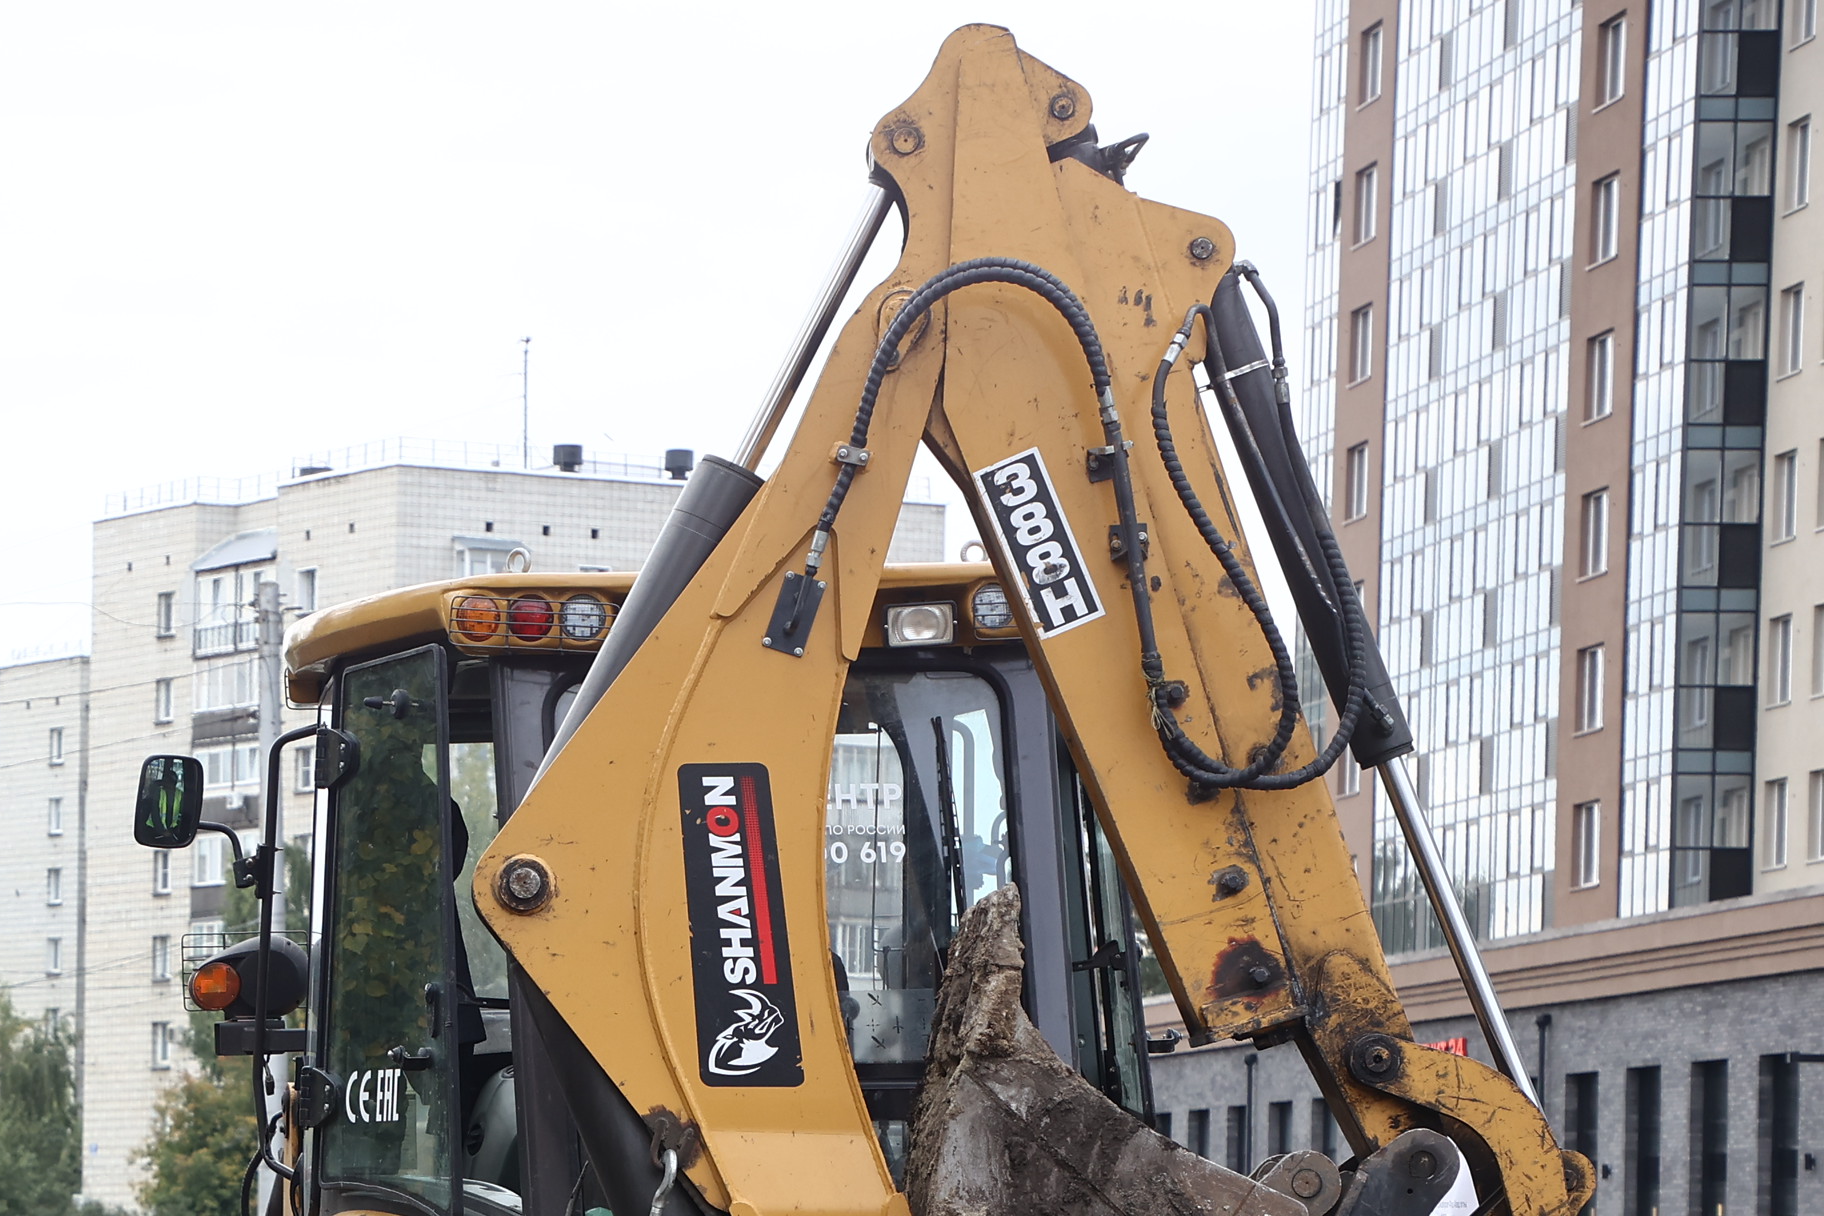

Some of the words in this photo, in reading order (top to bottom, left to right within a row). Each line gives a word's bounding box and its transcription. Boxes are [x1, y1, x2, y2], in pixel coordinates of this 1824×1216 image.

[993, 462, 1089, 628] 388H
[847, 824, 906, 835] РОССИИ
[860, 841, 906, 864] 619
[701, 776, 757, 985] SHANMON
[345, 1070, 372, 1124] CE
